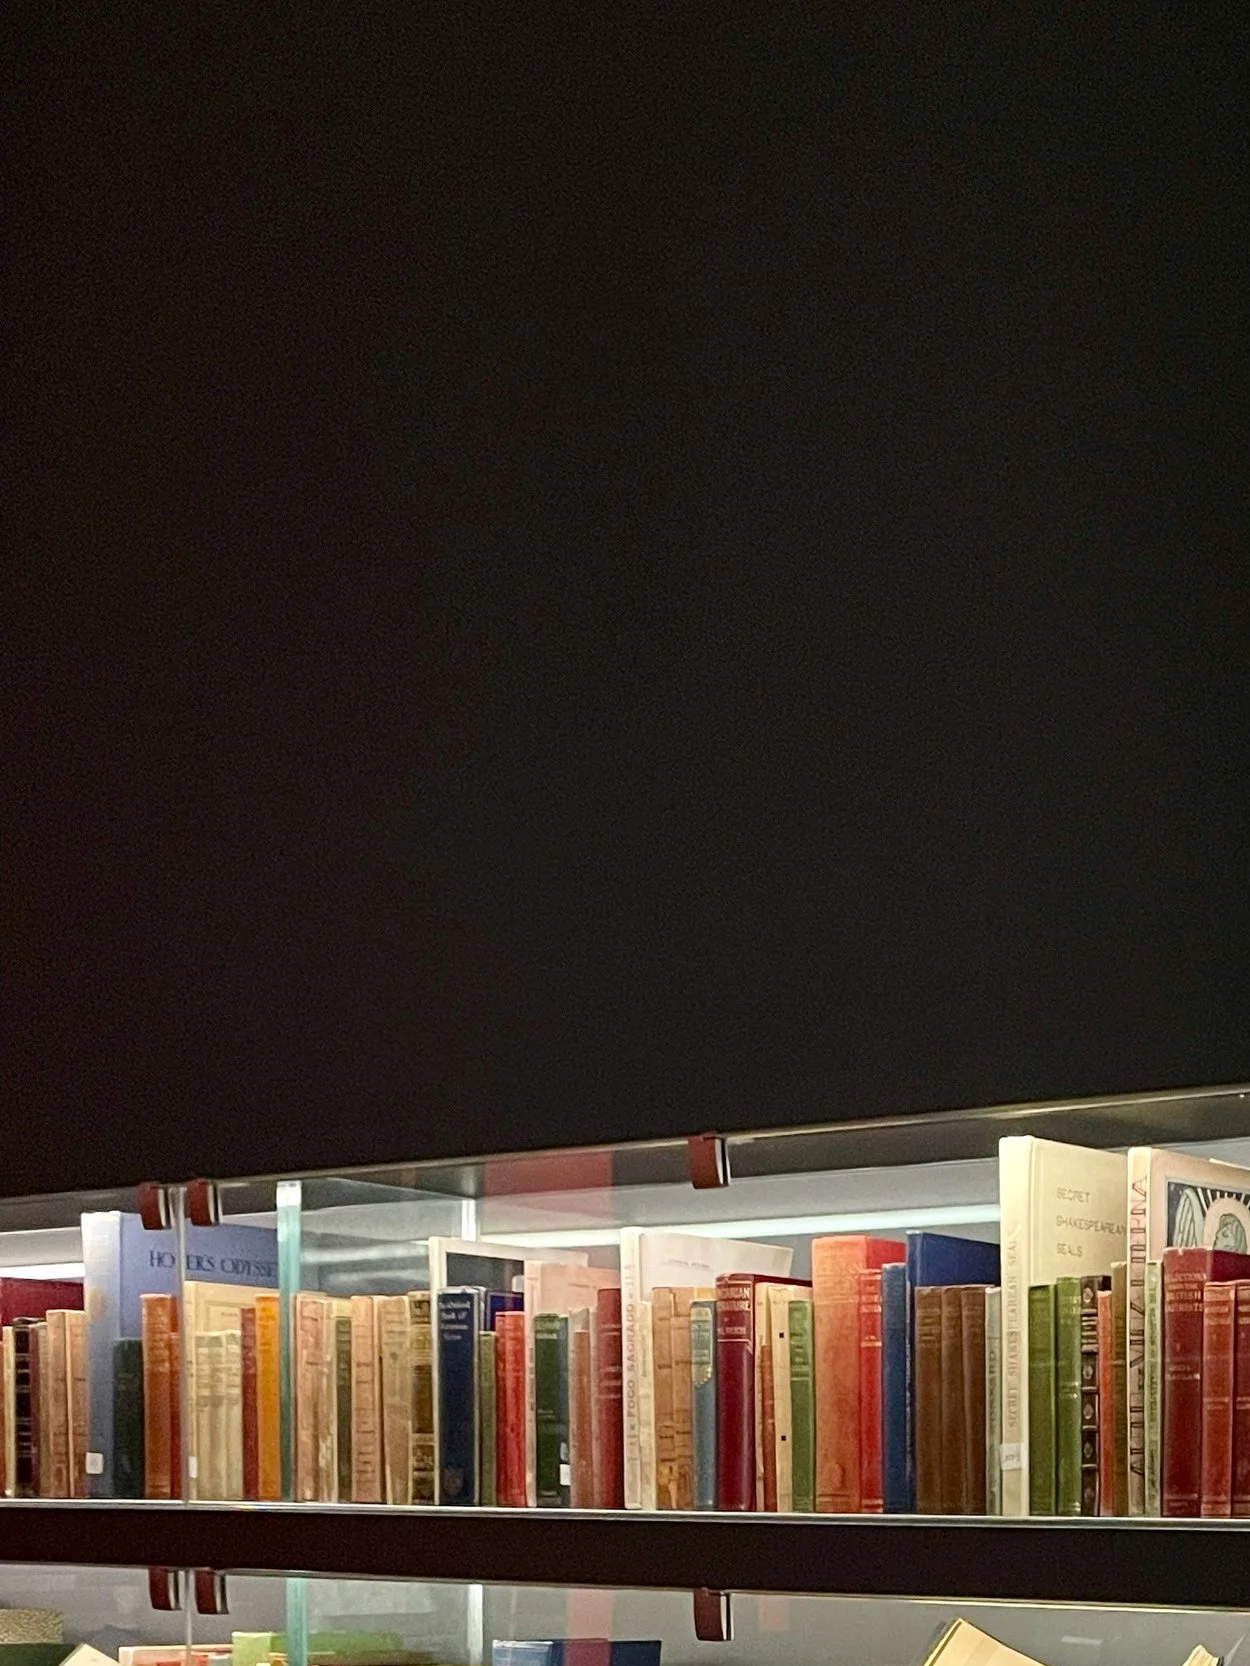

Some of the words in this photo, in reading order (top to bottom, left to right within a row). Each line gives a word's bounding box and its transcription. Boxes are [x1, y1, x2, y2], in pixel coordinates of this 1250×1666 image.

[1056, 1187, 1090, 1203] SECRET
[1056, 1243, 1083, 1258] SEALS
[150, 1250, 216, 1273] HOER'S
[220, 1257, 278, 1278] ODYSSE
[625, 1303, 637, 1374] SAGRADO
